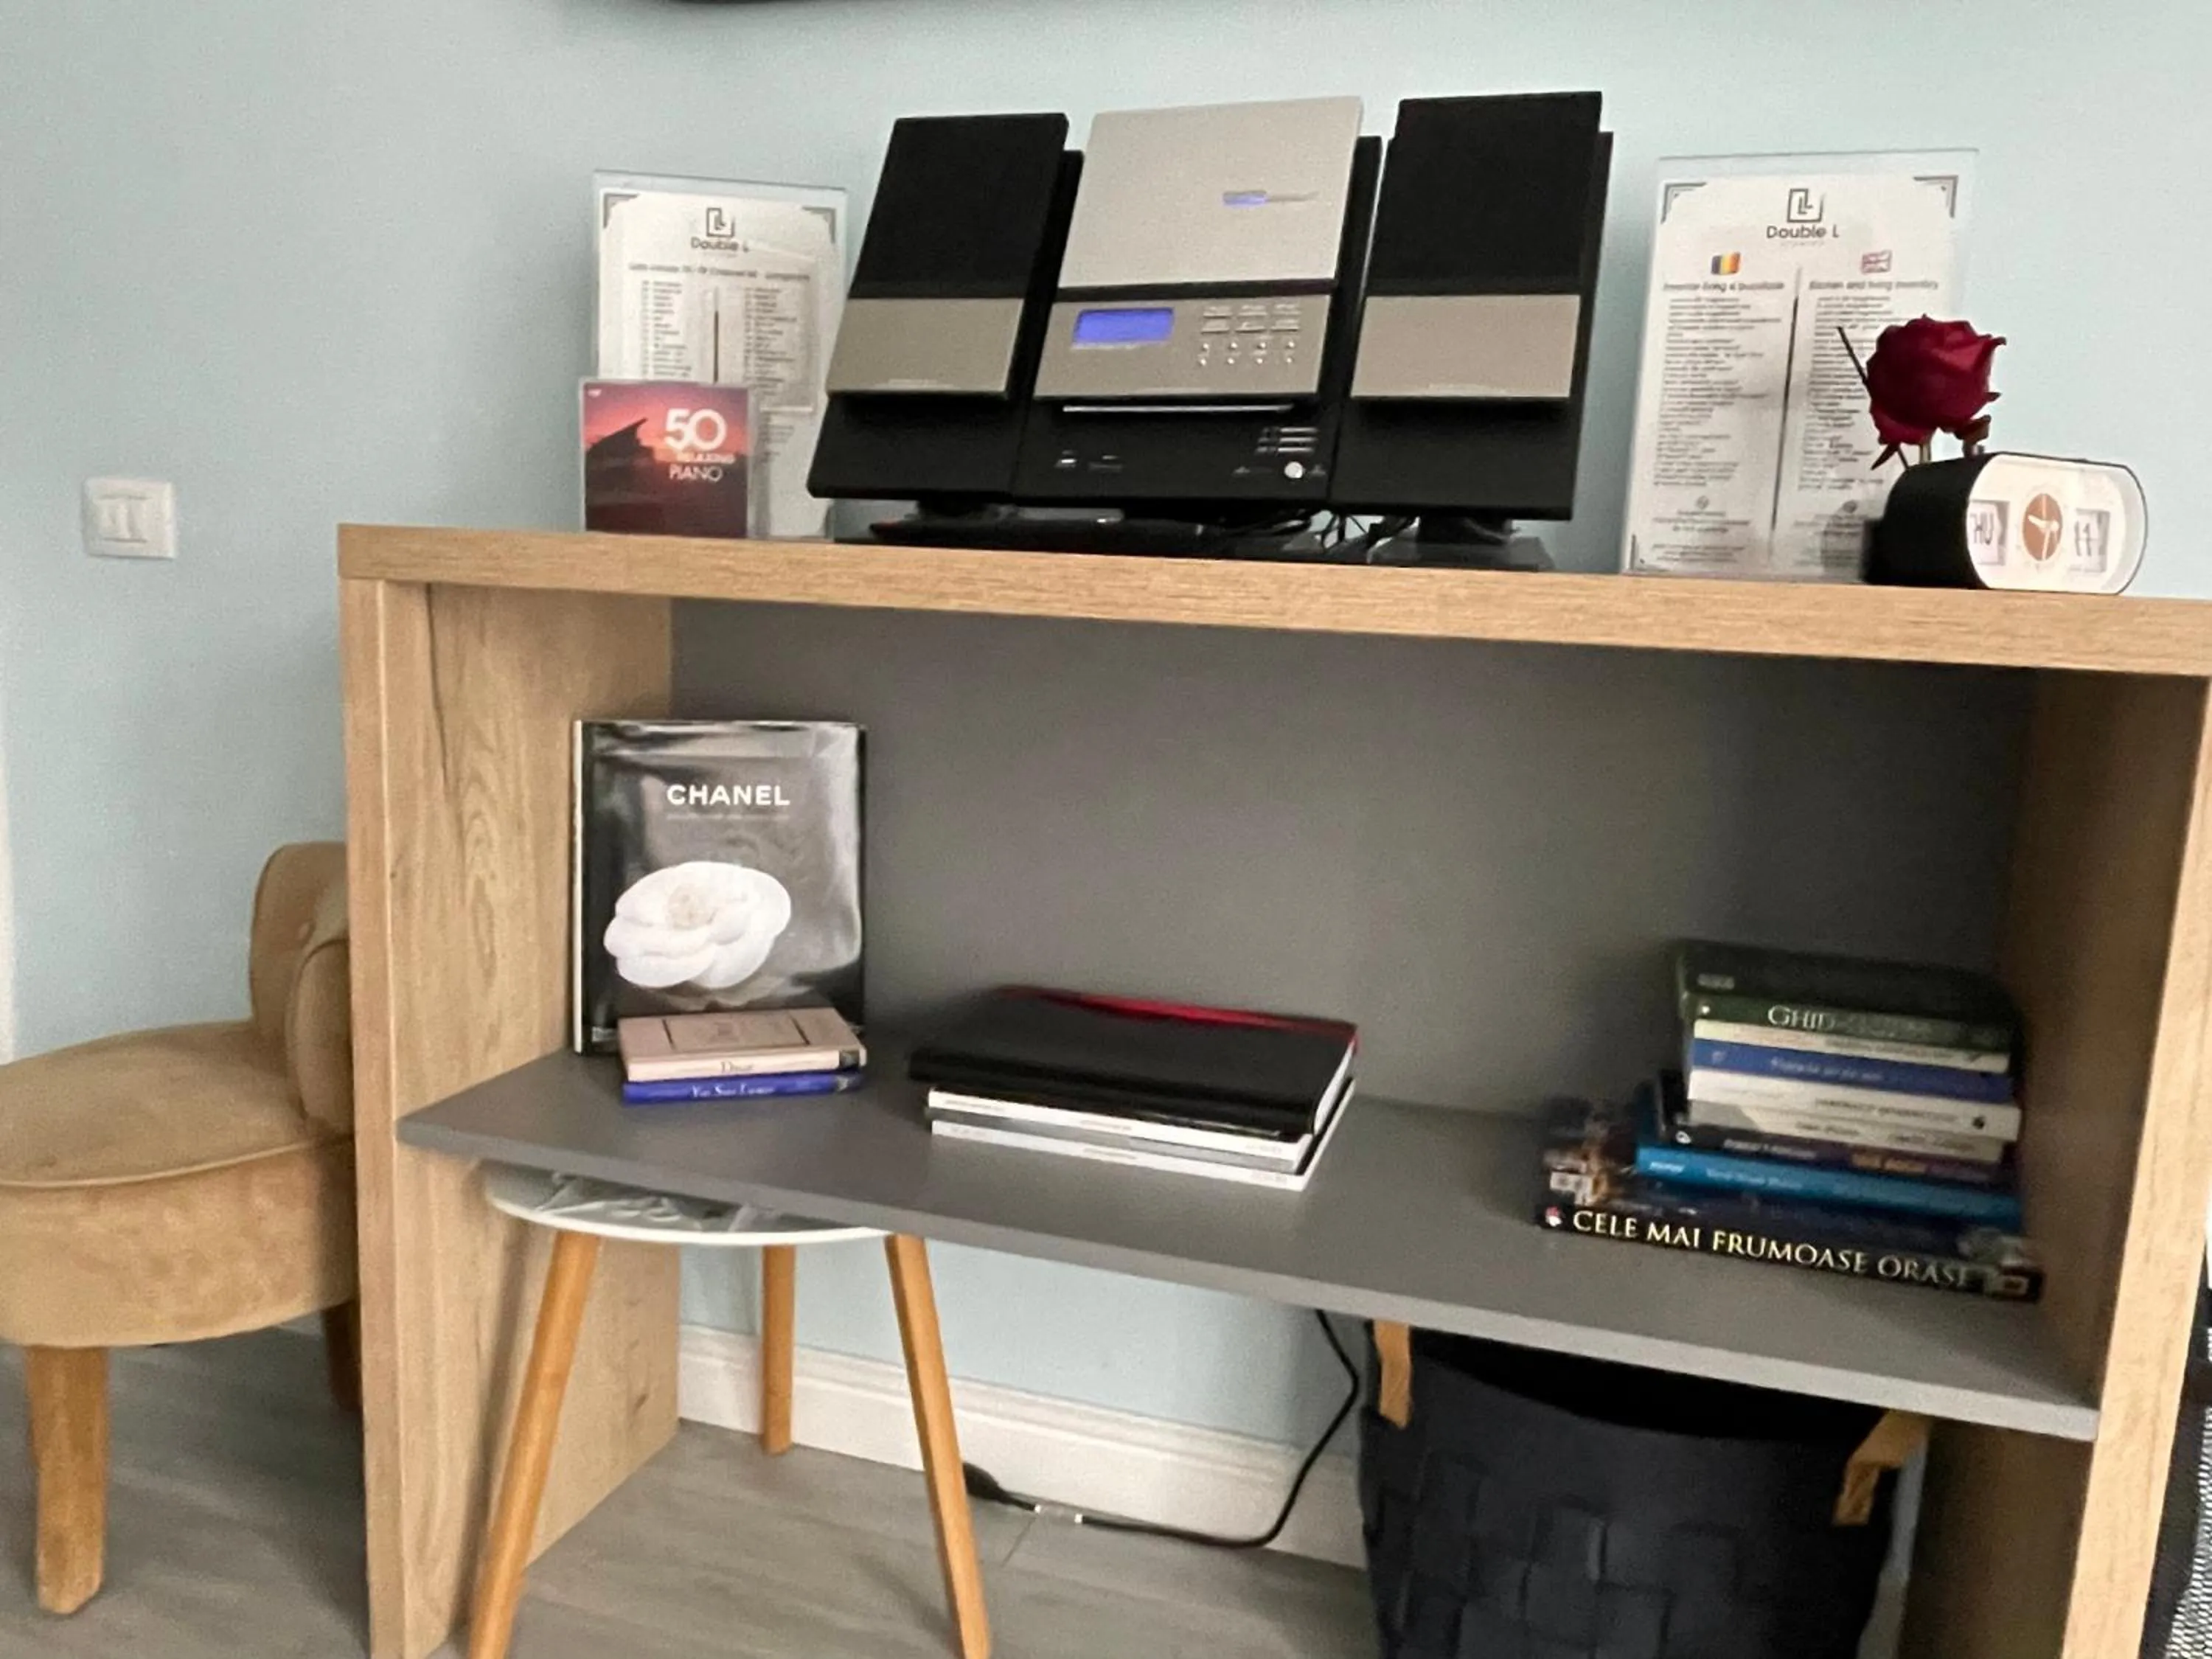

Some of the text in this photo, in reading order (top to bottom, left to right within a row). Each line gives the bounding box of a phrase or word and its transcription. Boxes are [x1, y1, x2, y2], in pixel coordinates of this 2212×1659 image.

[1766, 223, 1840, 239] Double L
[665, 408, 728, 452] 50
[667, 784, 791, 807] CHANEL
[1573, 1210, 1639, 1239] CELE
[1646, 1221, 1701, 1249] MAI
[1712, 1229, 1869, 1273] FRUMOASE
